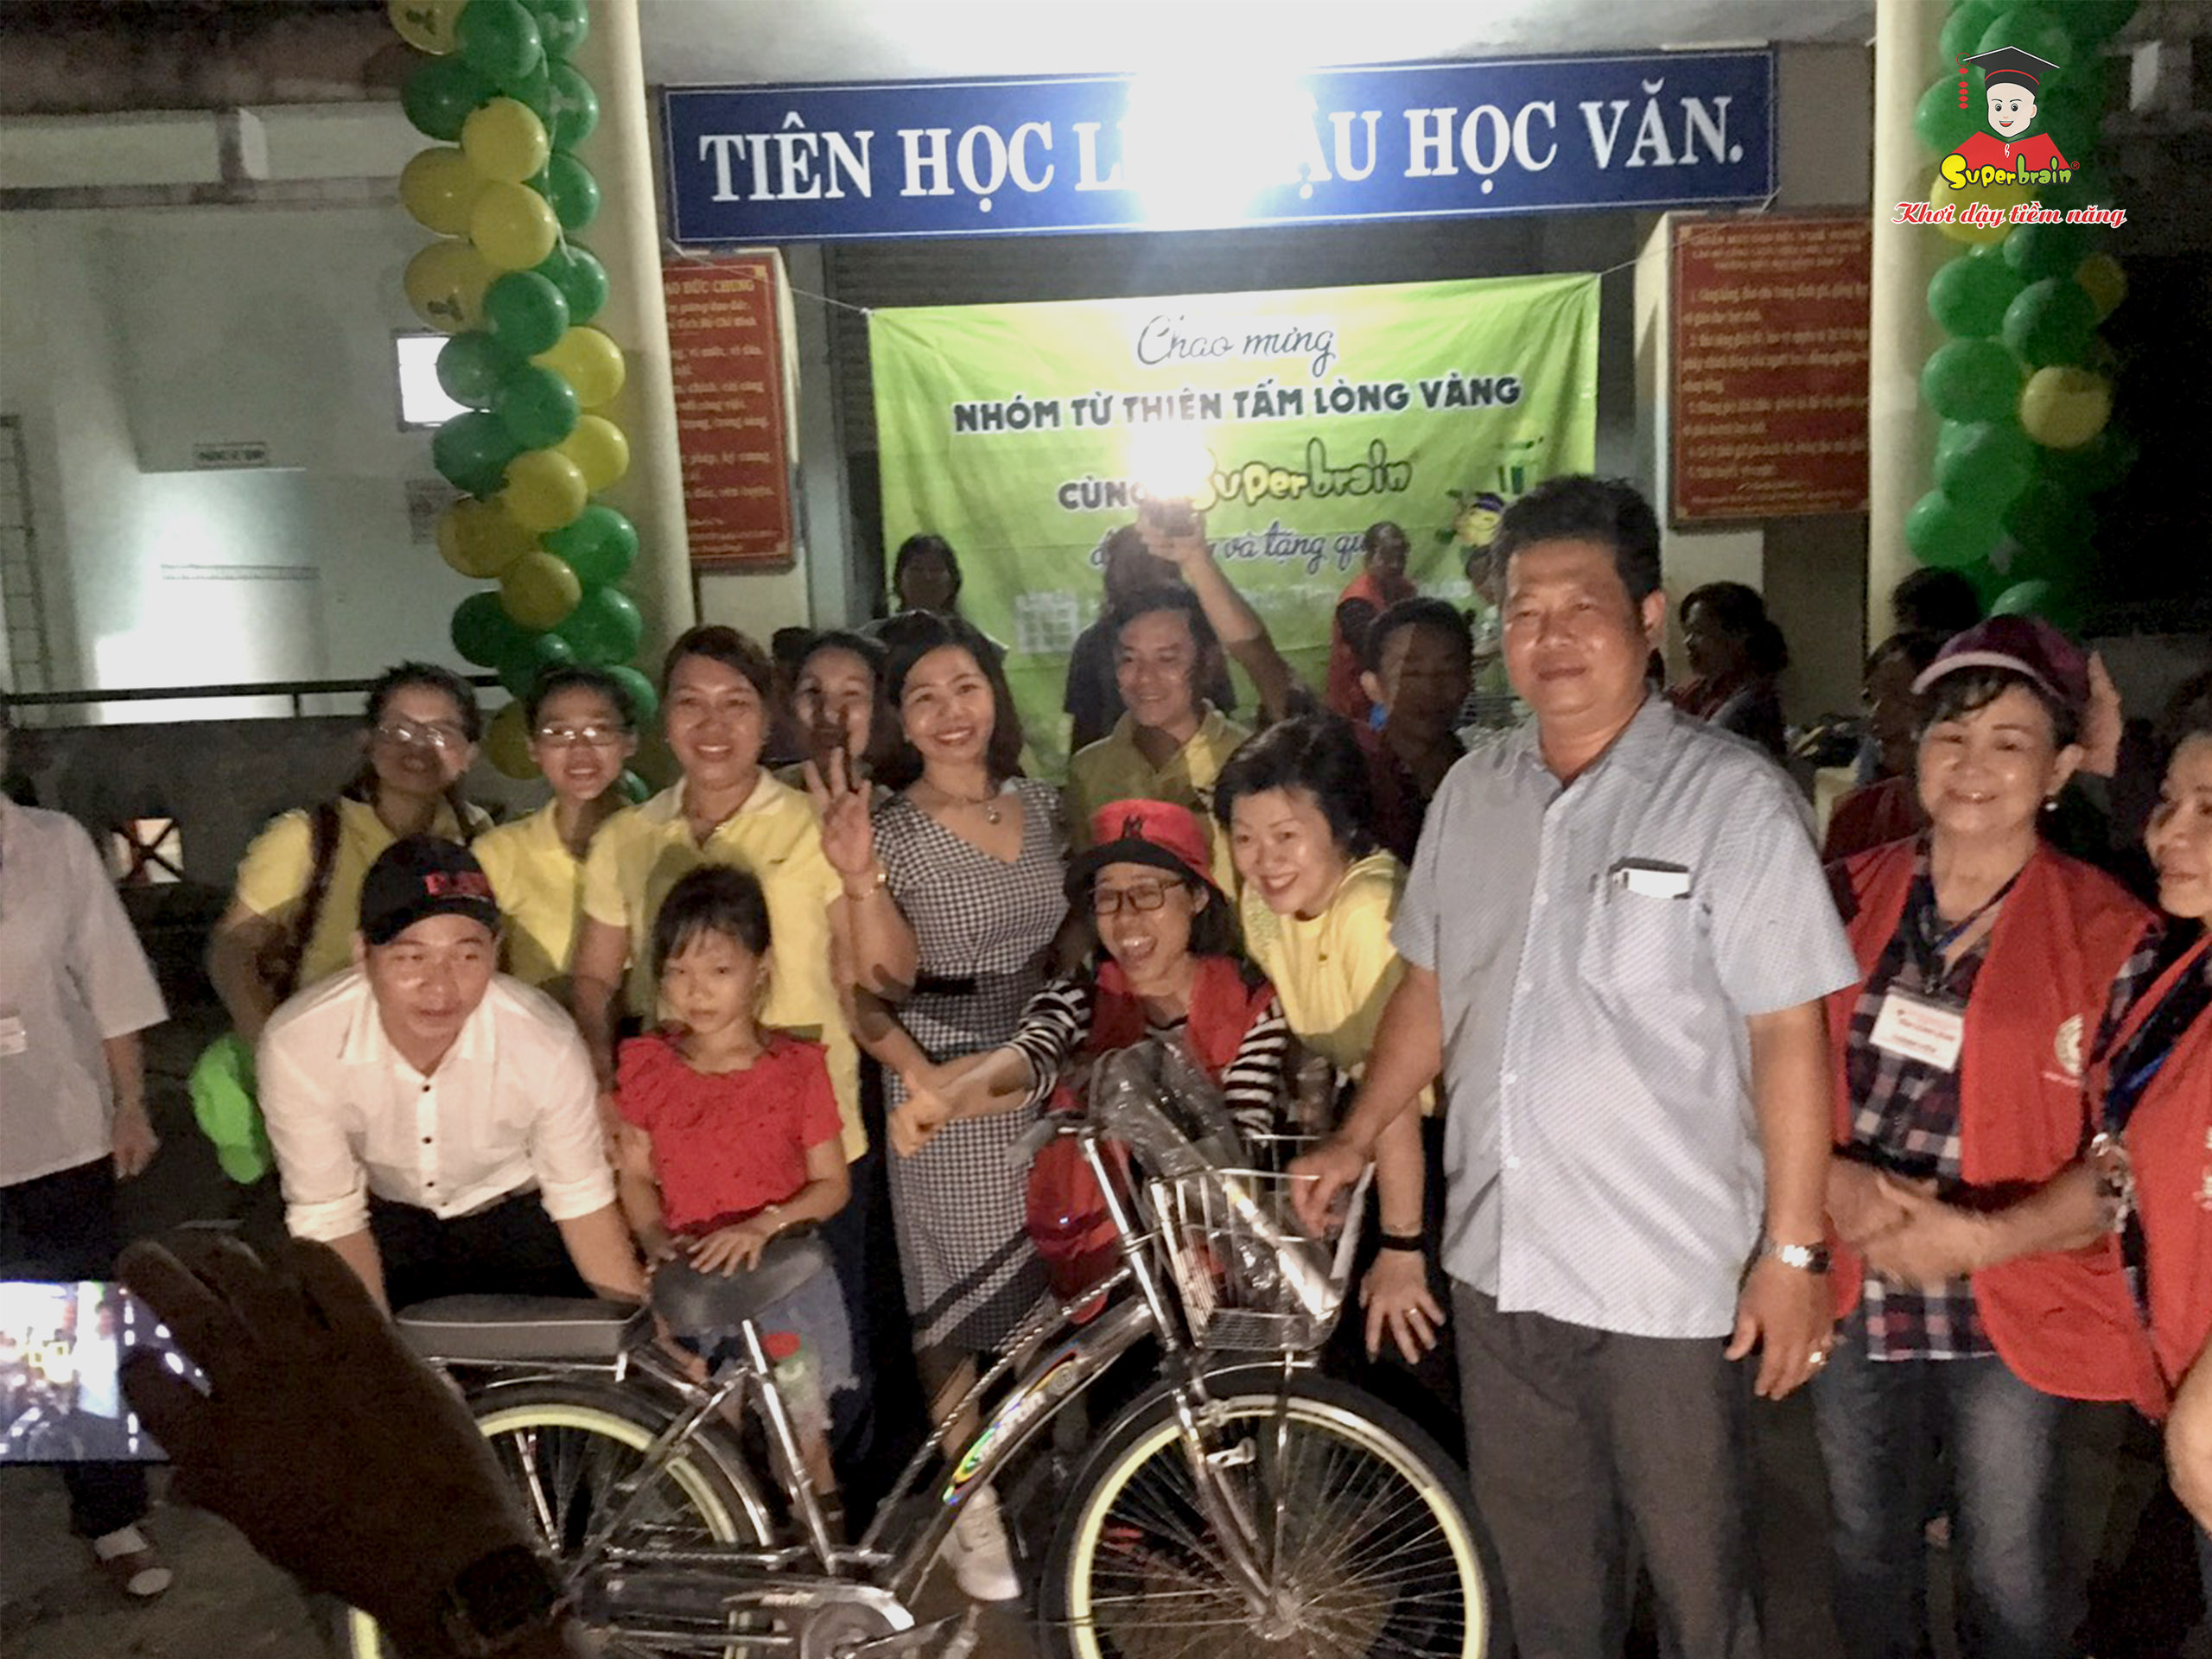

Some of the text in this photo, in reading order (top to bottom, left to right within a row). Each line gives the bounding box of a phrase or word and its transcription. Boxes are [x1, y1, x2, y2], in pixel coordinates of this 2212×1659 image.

[699, 111, 874, 202] TIÊN
[898, 121, 1055, 213] HỌC
[1403, 100, 1557, 194] HỌC
[1579, 77, 1744, 169] VĂN.
[954, 395, 1060, 432] NHÓM
[1314, 383, 1409, 414] LÒNG
